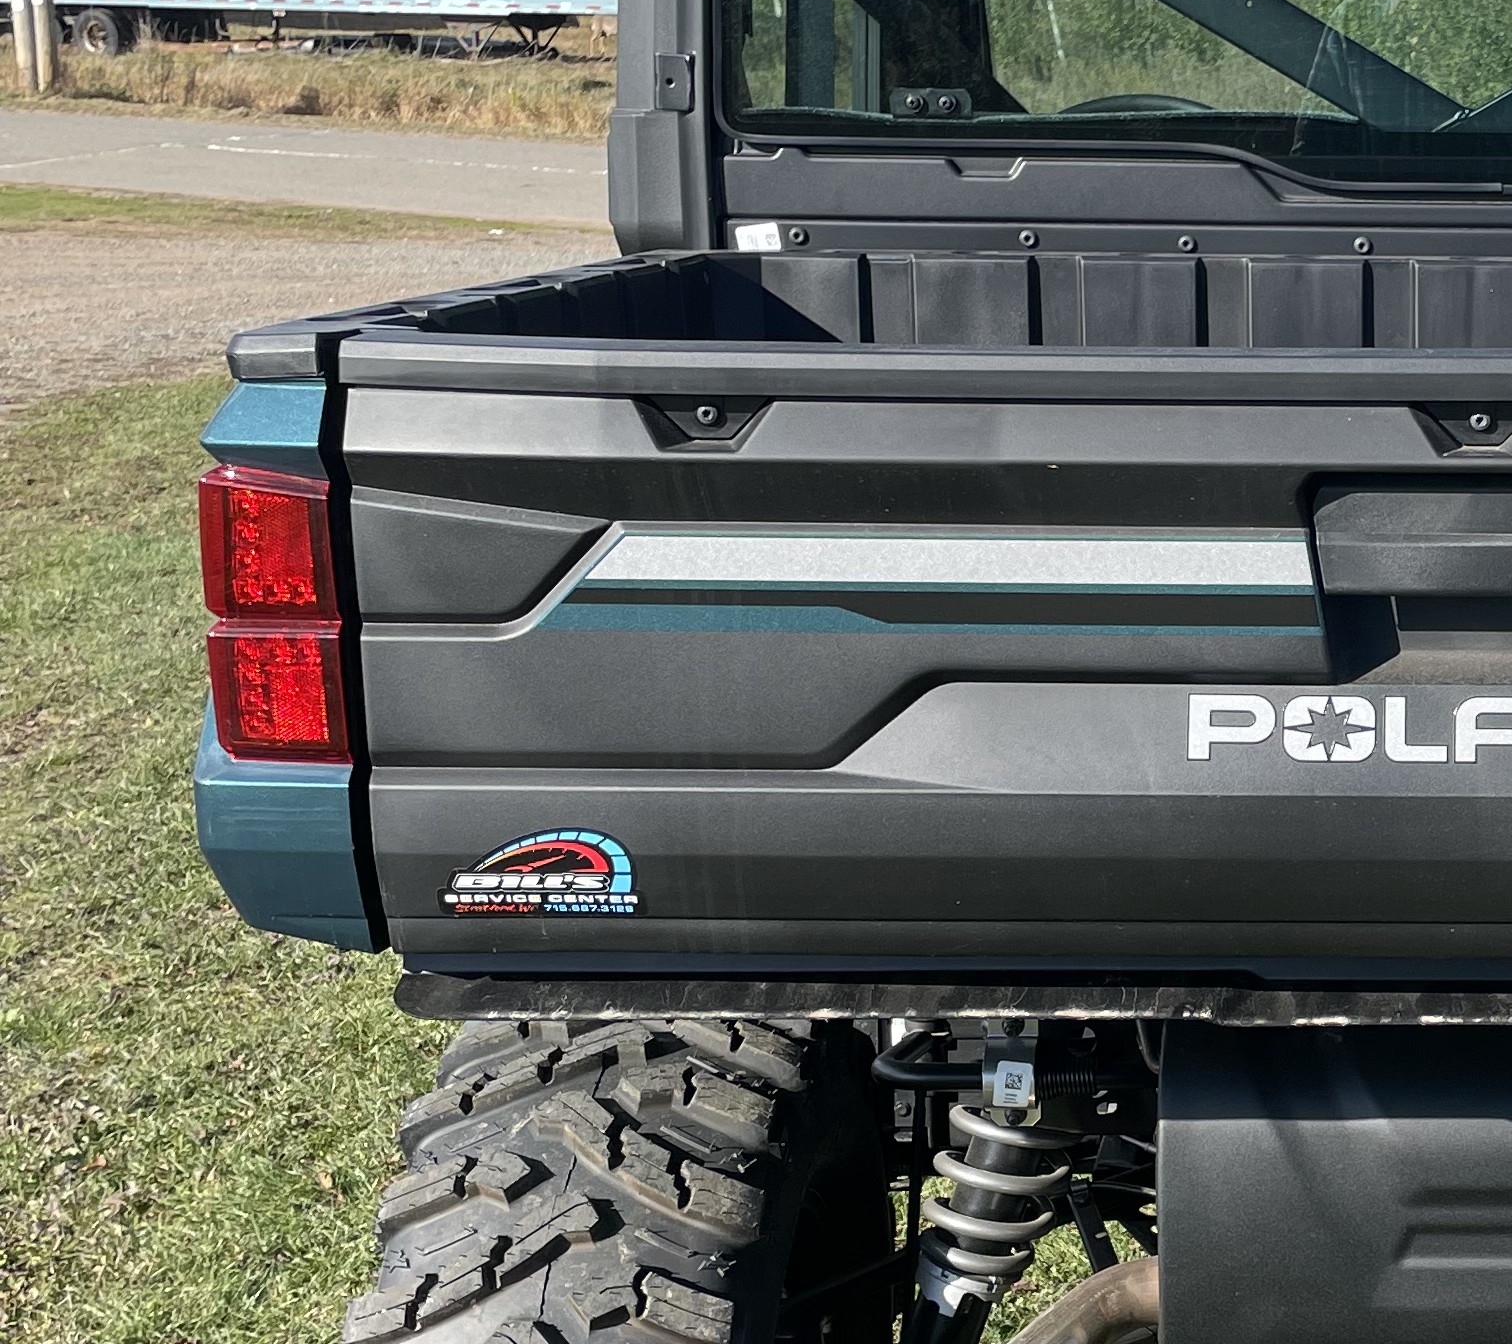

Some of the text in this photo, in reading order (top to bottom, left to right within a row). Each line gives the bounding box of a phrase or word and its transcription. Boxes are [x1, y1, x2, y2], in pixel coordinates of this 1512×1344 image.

[453, 873, 609, 891] BILL'S
[444, 894, 639, 904] SERVICE CENTER
